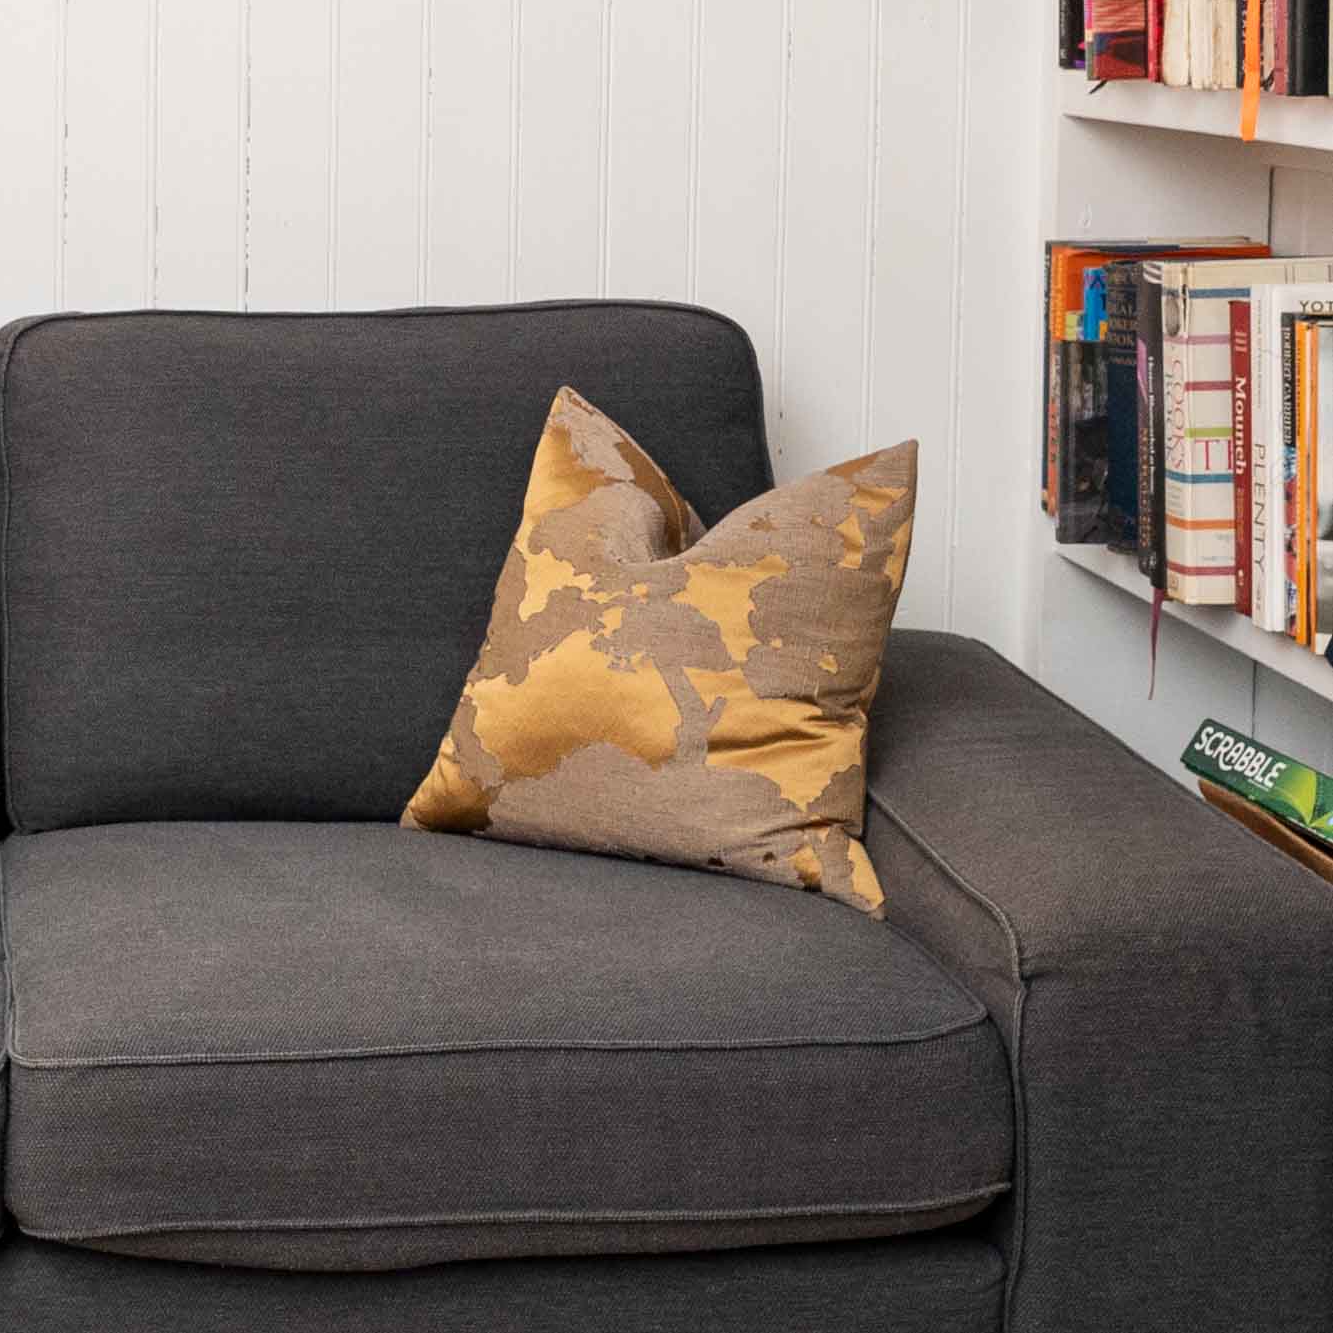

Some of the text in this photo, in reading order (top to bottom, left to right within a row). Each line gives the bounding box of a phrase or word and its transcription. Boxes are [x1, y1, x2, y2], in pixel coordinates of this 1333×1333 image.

[1282, 384, 1292, 445] CARRIER
[1252, 443, 1268, 573] PLENTY
[1194, 726, 1287, 788] SCRABBLE
